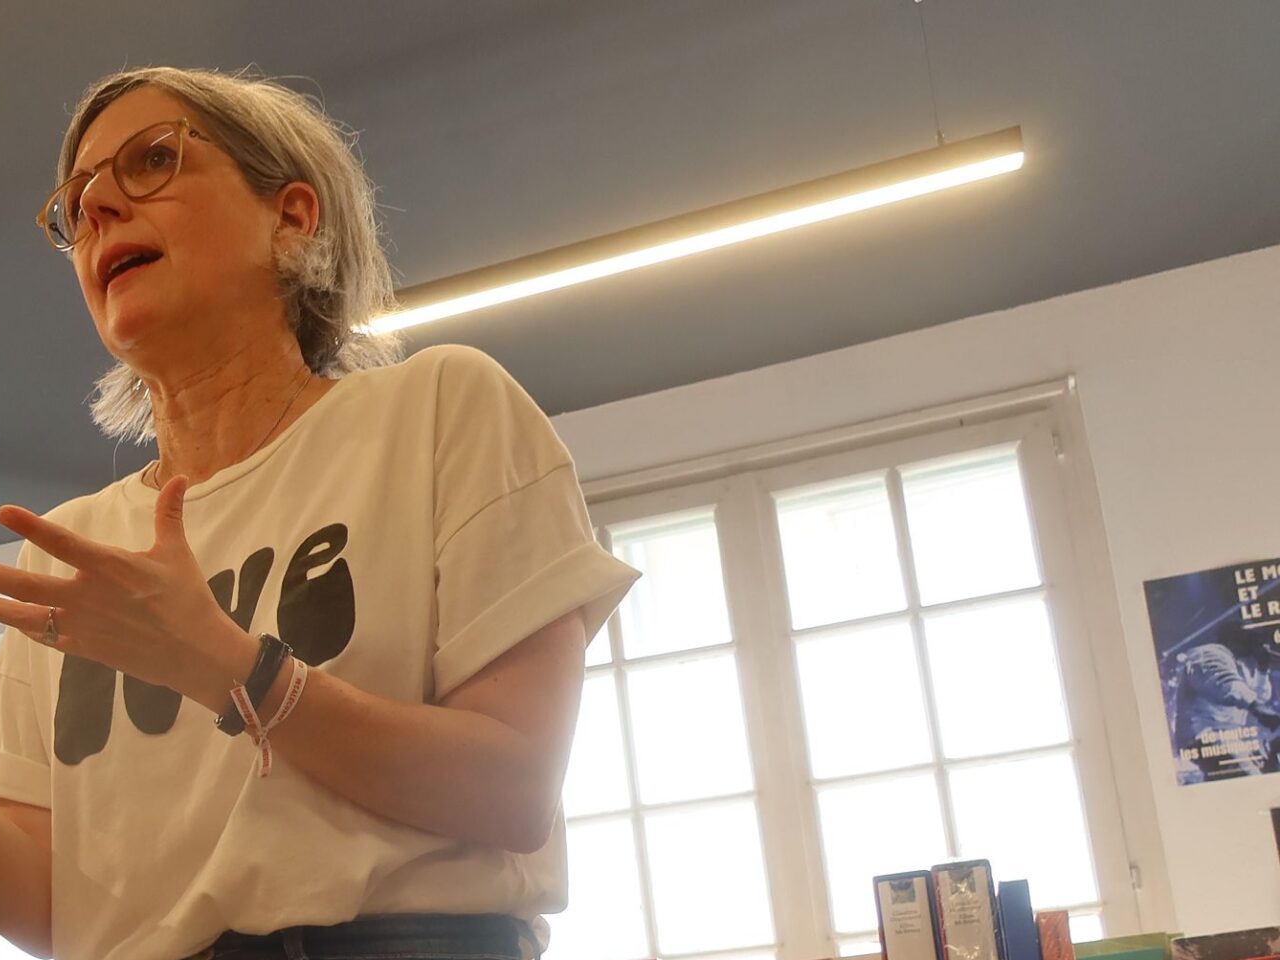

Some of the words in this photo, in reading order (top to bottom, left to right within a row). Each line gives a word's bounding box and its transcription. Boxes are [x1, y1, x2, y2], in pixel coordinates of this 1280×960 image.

[1234, 568, 1256, 585] LE
[1261, 563, 1280, 580] M
[1237, 585, 1259, 602] ET
[1240, 603, 1262, 620] LE
[1180, 748, 1199, 761] les
